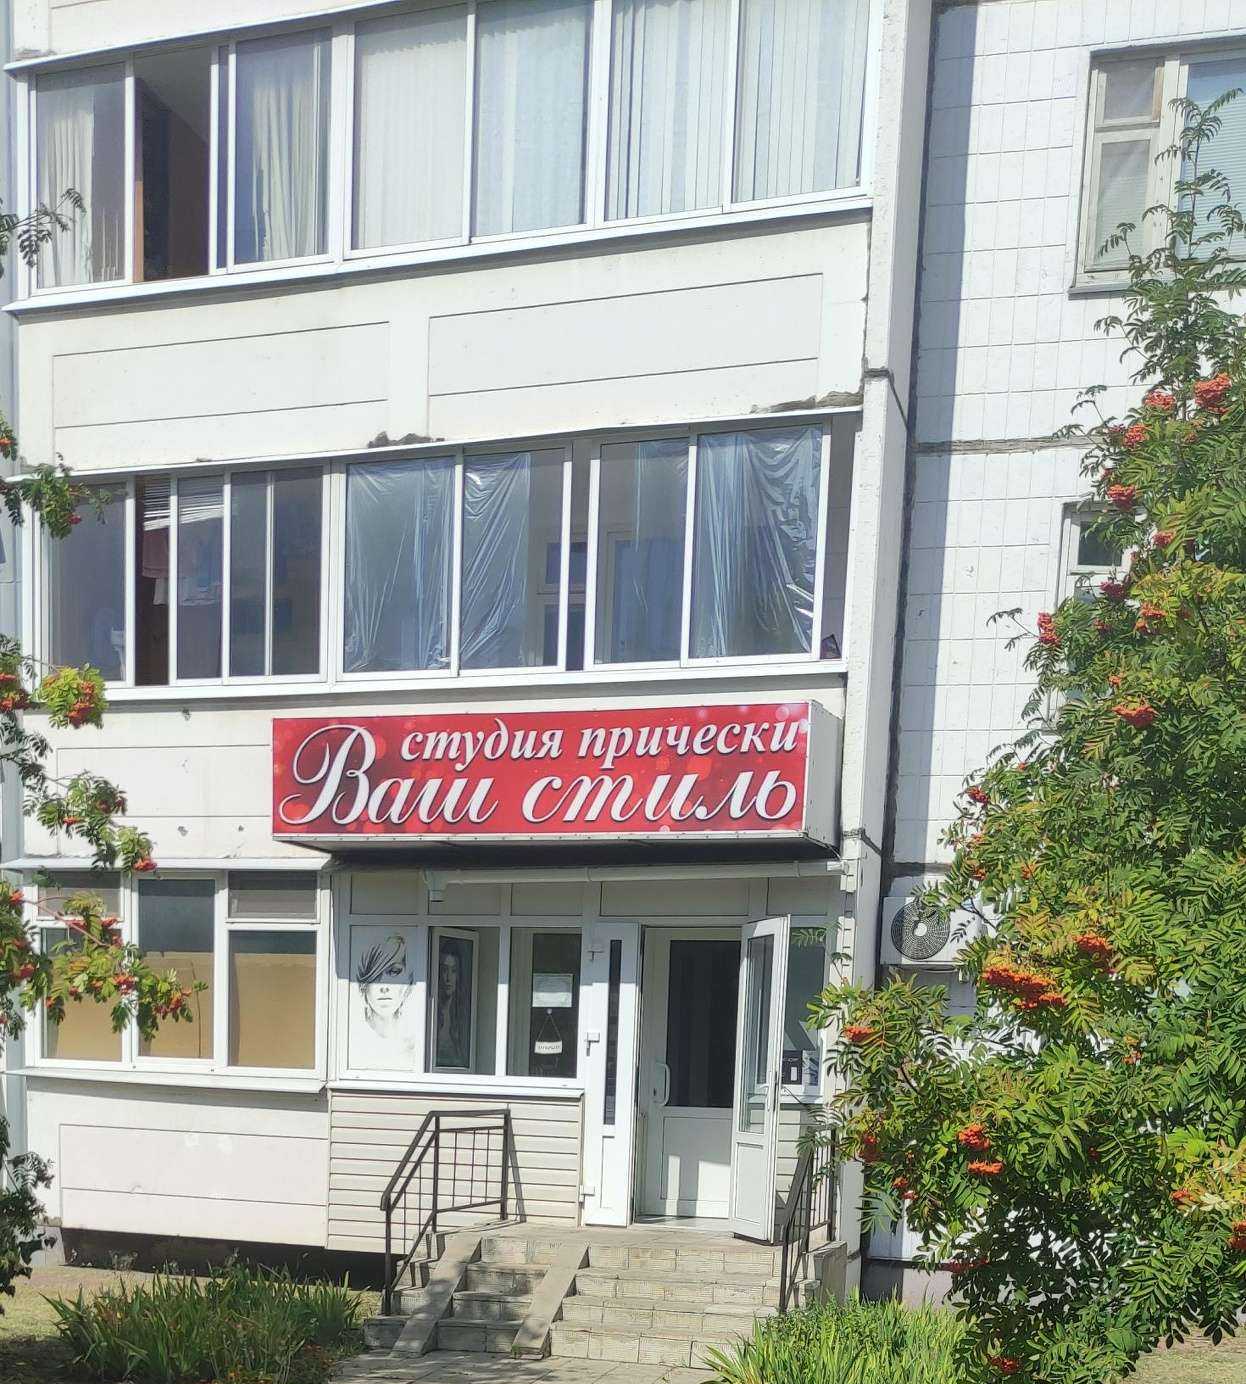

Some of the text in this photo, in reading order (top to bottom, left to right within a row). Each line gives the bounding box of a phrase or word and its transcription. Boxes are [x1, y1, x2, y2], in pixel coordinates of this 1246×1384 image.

[280, 724, 797, 824] Ваш стиль
[402, 719, 798, 771] студия прически
